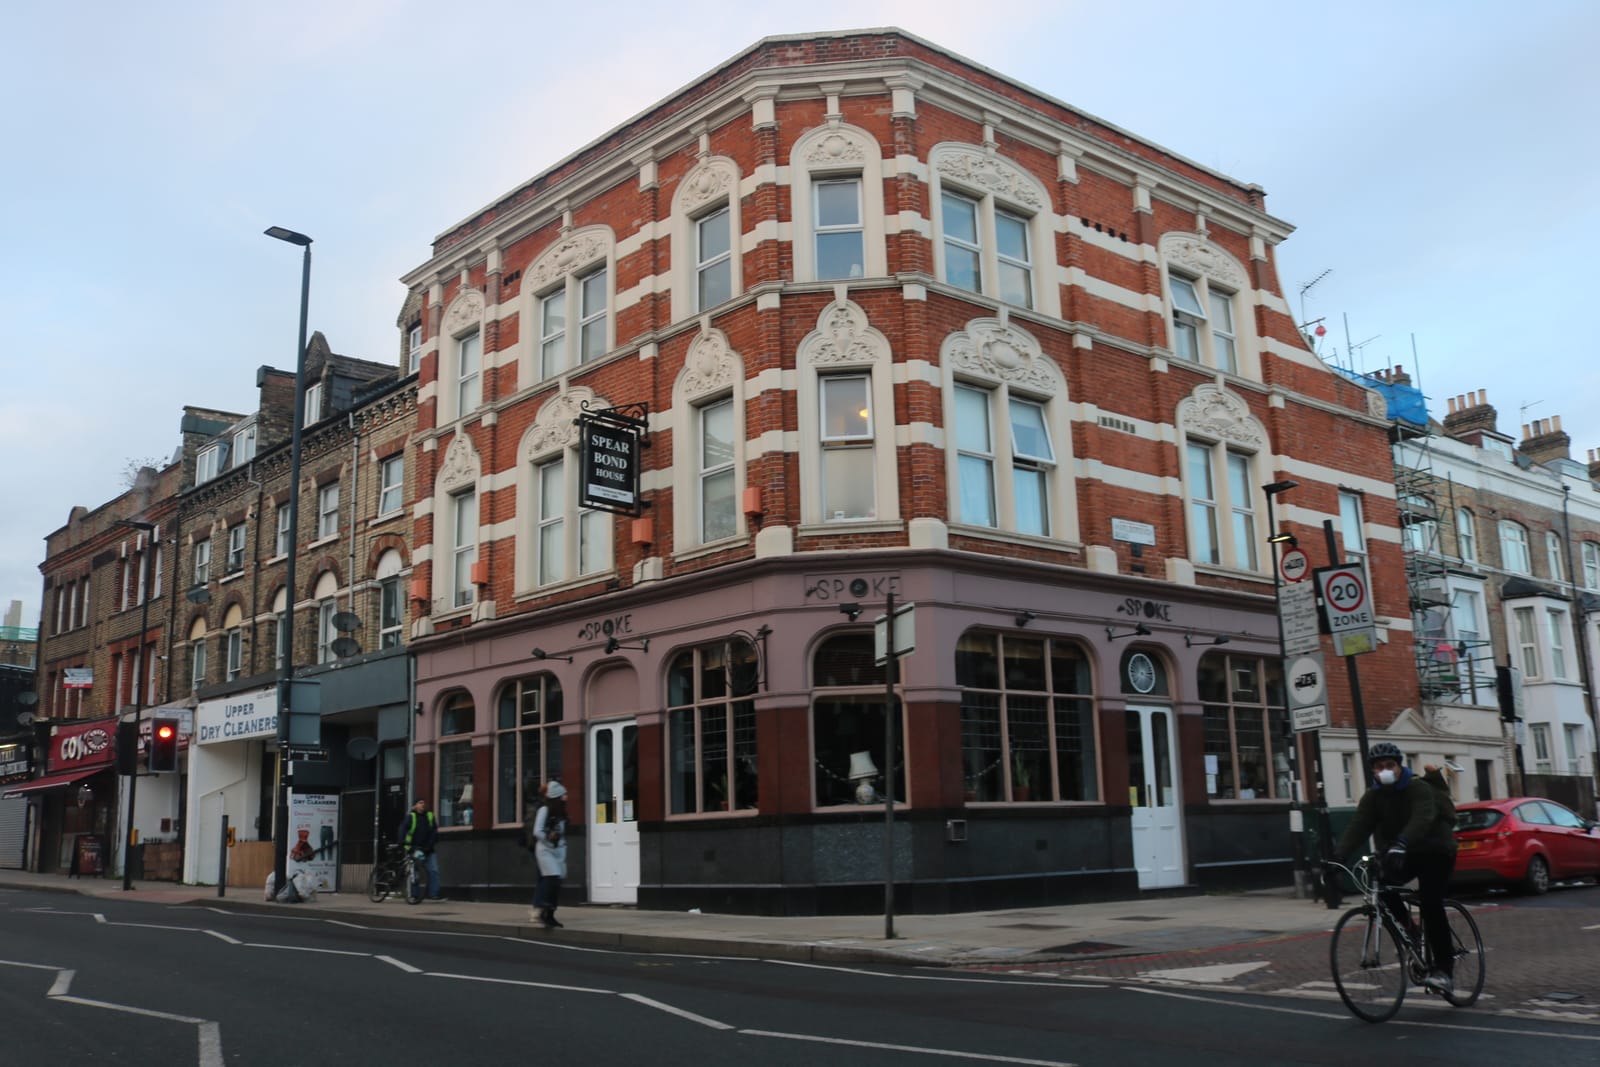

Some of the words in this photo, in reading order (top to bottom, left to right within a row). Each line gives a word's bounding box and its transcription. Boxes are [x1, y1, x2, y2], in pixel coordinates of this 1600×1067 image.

[591, 434, 630, 454] SPEAR
[593, 452, 628, 470] BOND
[595, 467, 626, 482] HOUSE
[816, 576, 901, 600] SPOKE
[1331, 582, 1358, 602] 20
[1125, 598, 1172, 622] SPOKE
[1333, 612, 1369, 627] ZONE
[585, 614, 632, 640] SPOKE
[225, 703, 255, 718] UPPER
[200, 725, 221, 741] DRY
